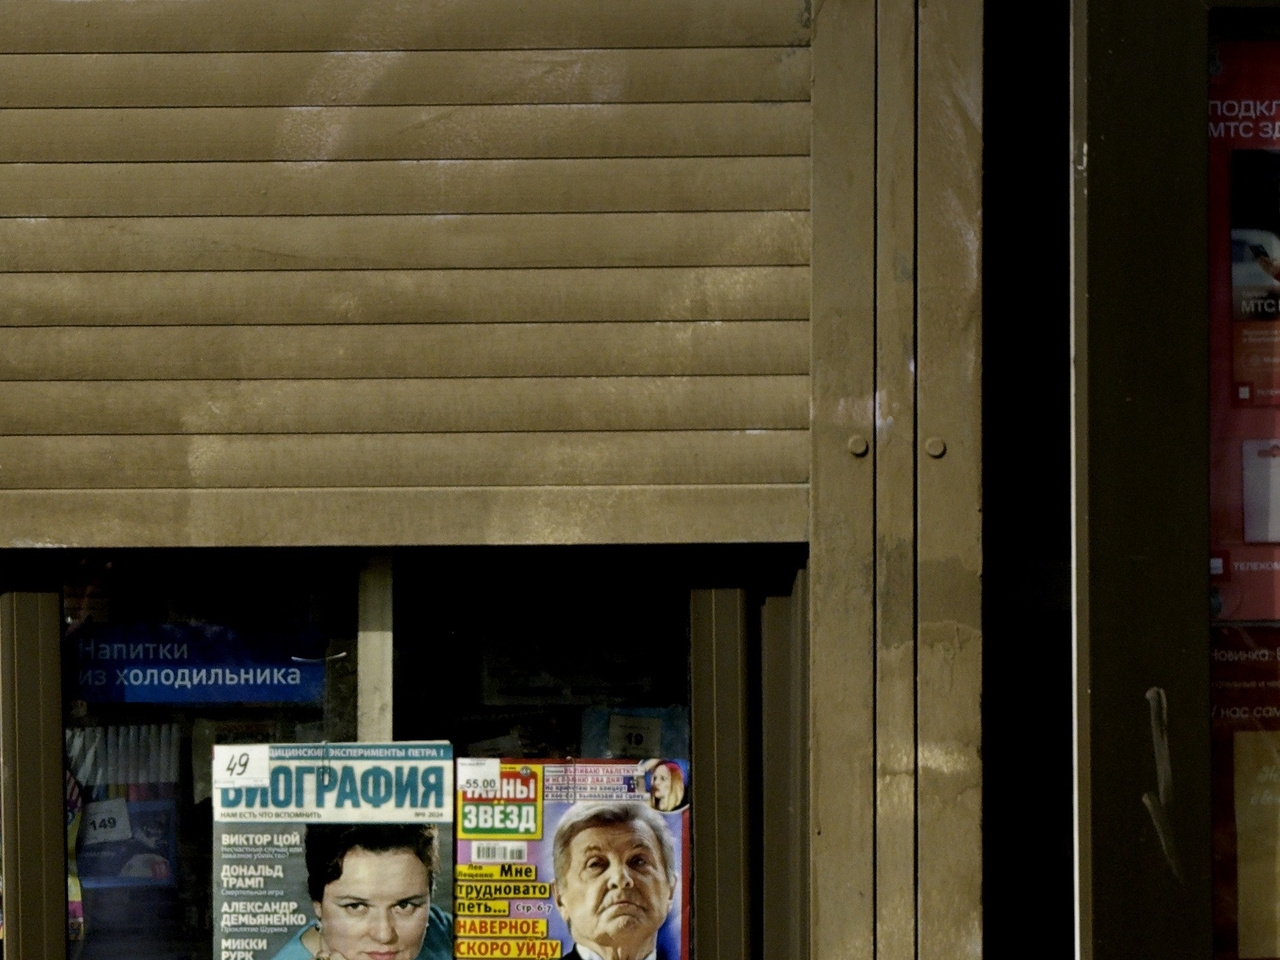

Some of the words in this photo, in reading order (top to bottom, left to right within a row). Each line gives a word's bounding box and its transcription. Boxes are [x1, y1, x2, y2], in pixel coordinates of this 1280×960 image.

[80, 643, 188, 660] Напитки
[80, 671, 106, 685] из
[116, 667, 301, 689] холодильника
[329, 747, 405, 758] ЭКСПЕРИМЕНТЫ
[407, 747, 438, 758] ПЕТРА
[226, 752, 250, 776] 49
[465, 778, 496, 789] 55.00
[275, 811, 322, 819] ВСПОМНИТЬ
[463, 799, 536, 834] ЗВЁЗД
[87, 816, 117, 831] 149
[221, 834, 271, 846] ВИКТОР
[273, 831, 301, 847] ЦОЙ
[221, 865, 284, 878] ДОНАЛЬД
[500, 863, 533, 878] Мне
[221, 877, 264, 889] ТРАМП
[457, 882, 548, 900] трудновато
[221, 901, 298, 915] АЛЕКСАНДР
[457, 902, 507, 914] петь...
[515, 903, 536, 913] Стр.
[221, 913, 307, 926] ДЕМЬЯНЕНКО
[457, 920, 545, 938] НАВЕРНОЕ,
[221, 938, 267, 950] МИККИ
[457, 942, 514, 957] СКОРО
[515, 936, 560, 960] УЙДУ
